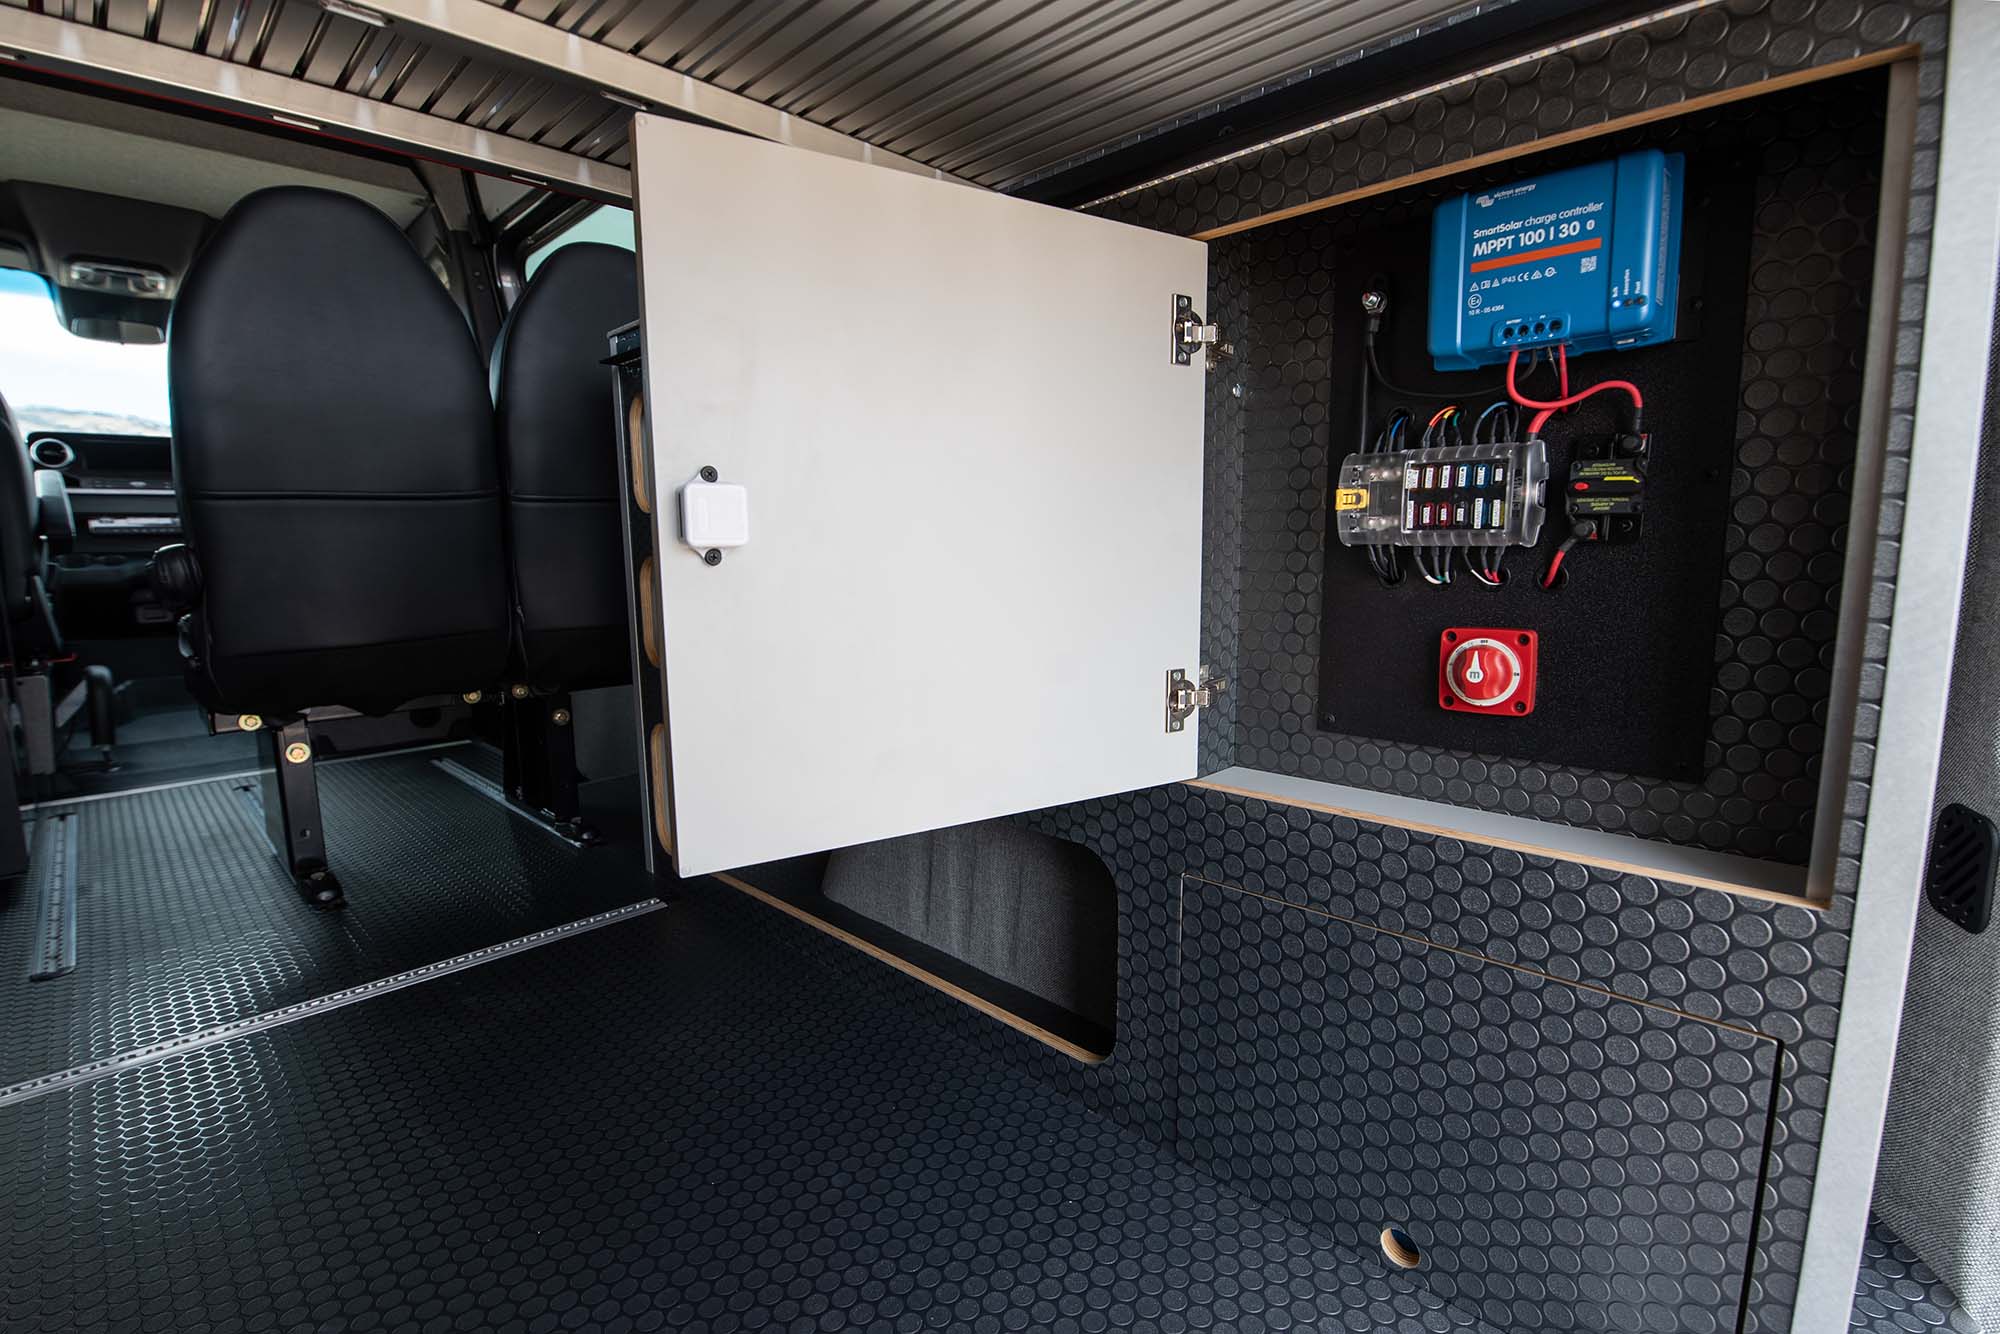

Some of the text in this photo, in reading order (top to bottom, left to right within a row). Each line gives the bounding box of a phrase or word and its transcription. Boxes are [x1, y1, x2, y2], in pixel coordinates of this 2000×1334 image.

[1515, 183, 1537, 192] energy
[1472, 234, 1516, 257] MPPT
[1518, 228, 1546, 247] 100
[1558, 220, 1581, 239] 30
[1473, 201, 1604, 239] SmartSolar charge controller
